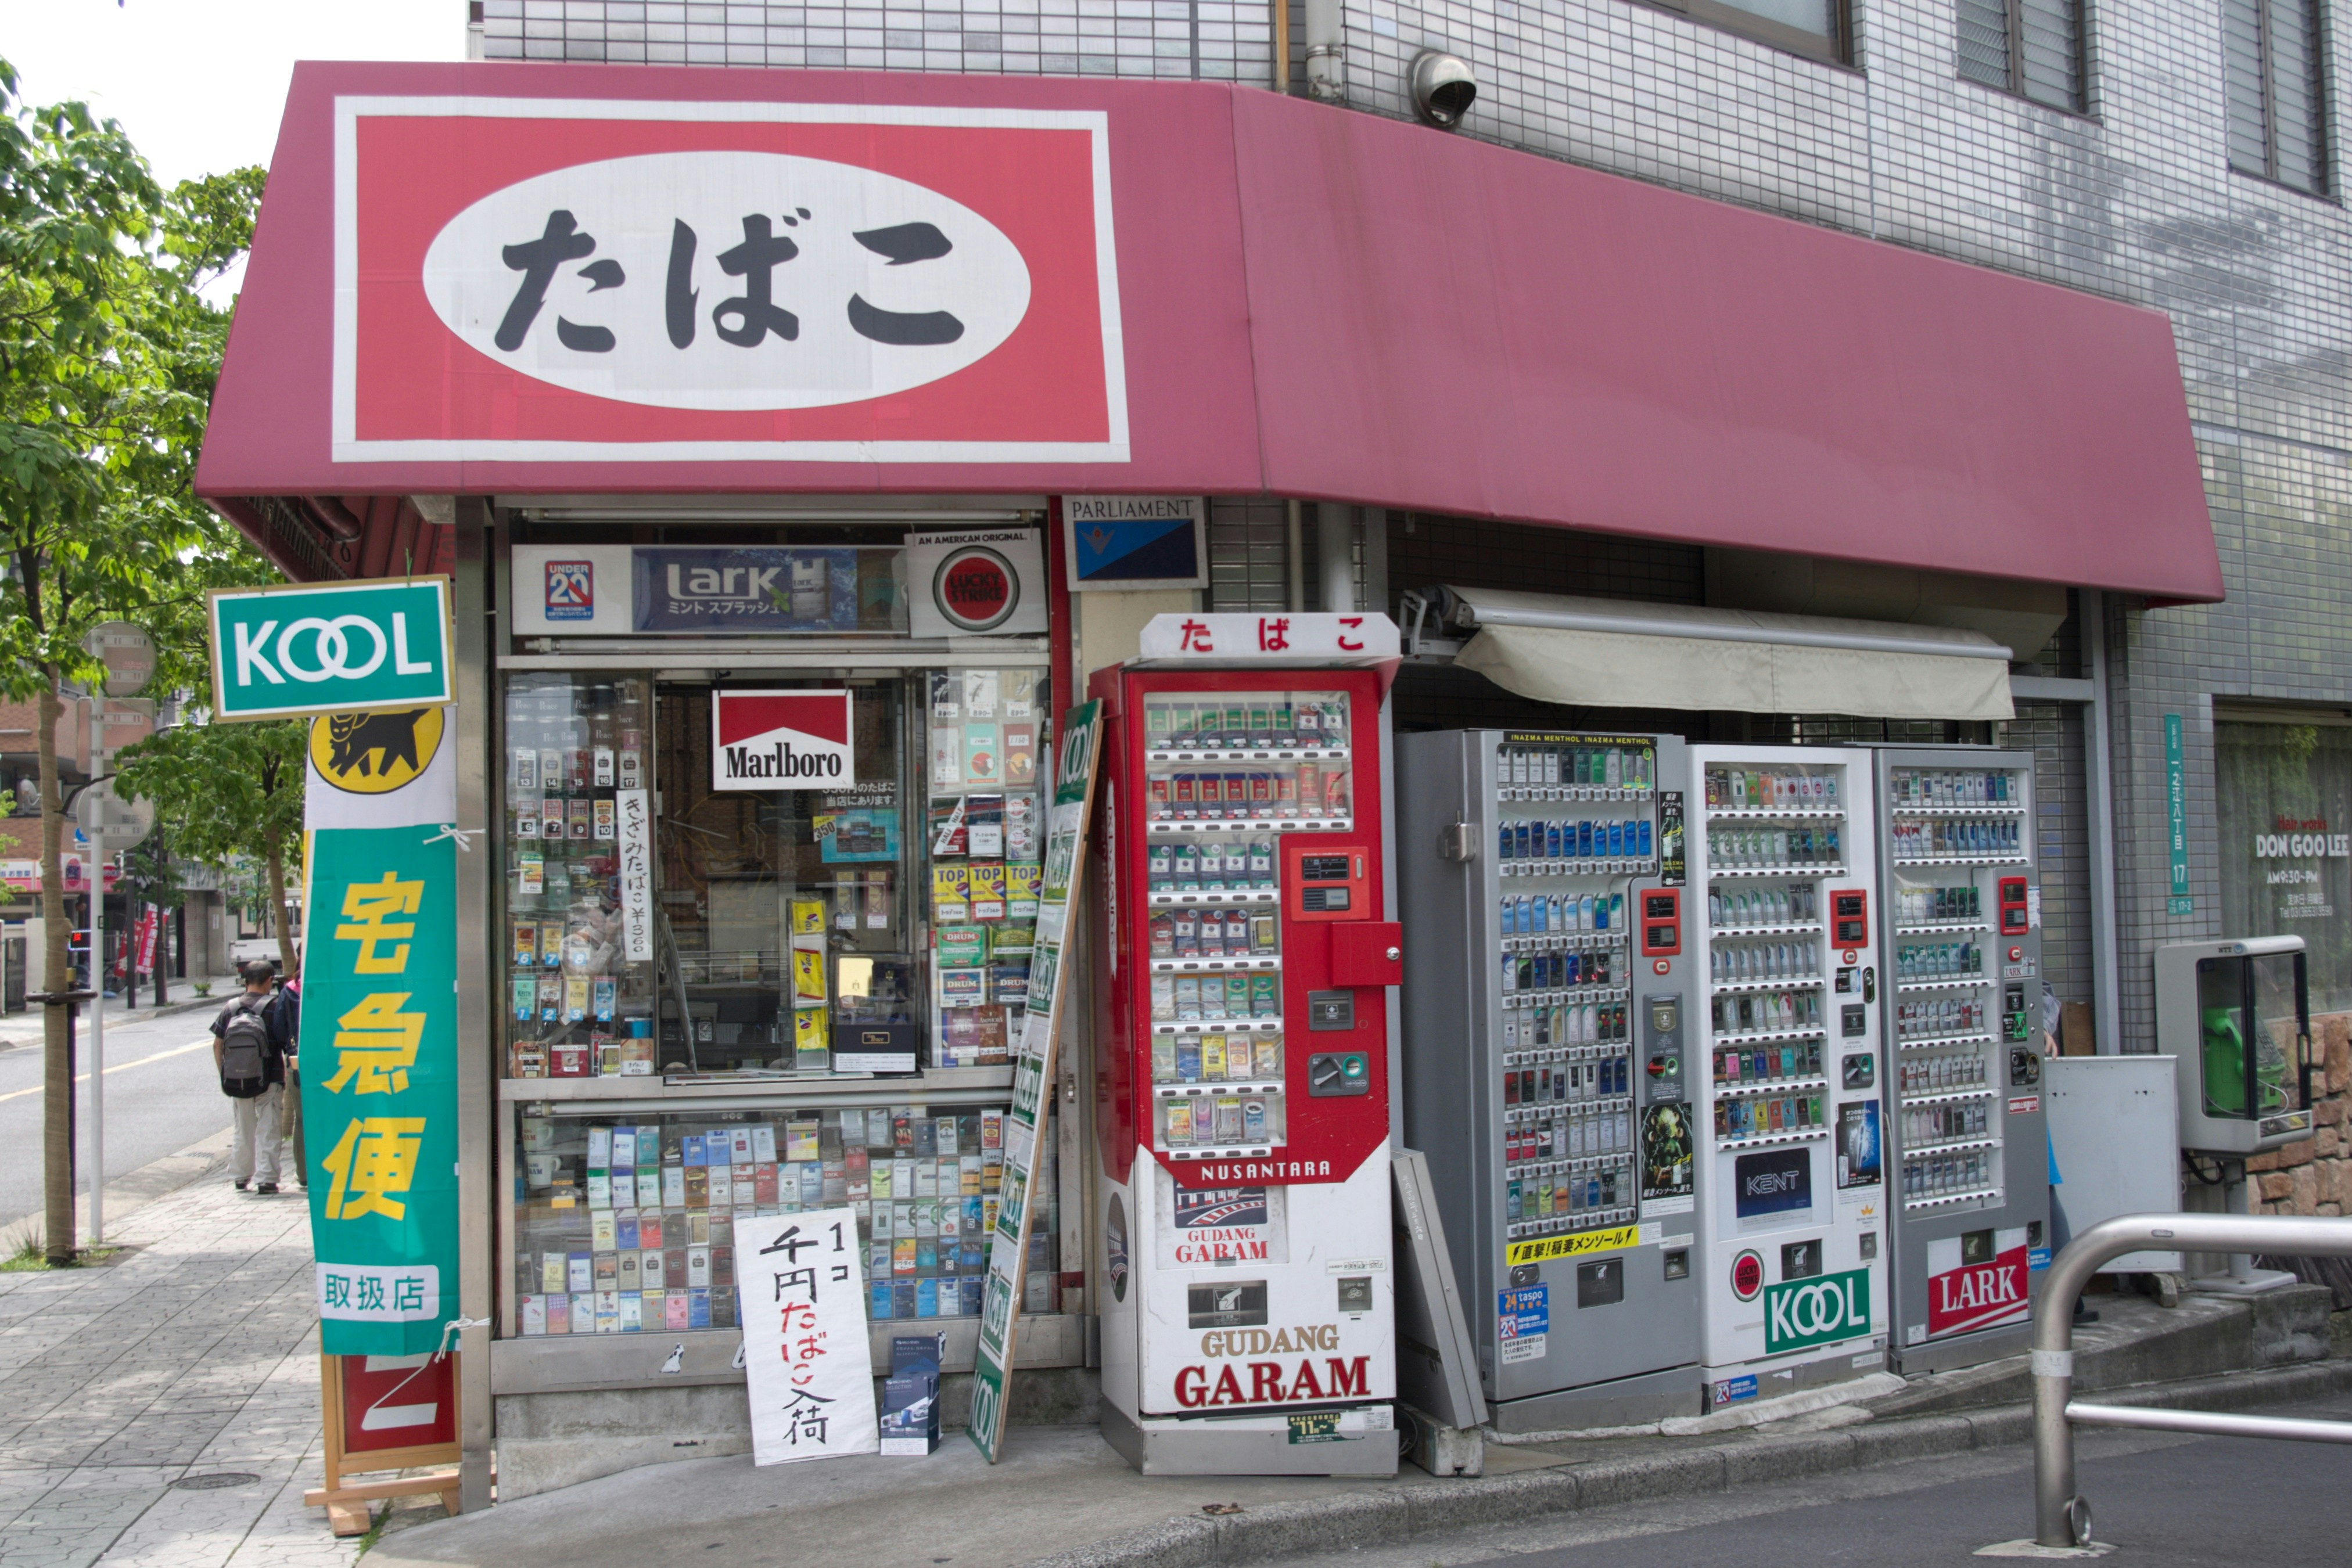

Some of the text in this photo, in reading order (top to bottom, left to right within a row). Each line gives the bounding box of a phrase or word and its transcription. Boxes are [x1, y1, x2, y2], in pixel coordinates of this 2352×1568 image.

[494, 207, 964, 352] たばこ
[1073, 500, 1193, 518] PARLIAMENT
[935, 534, 980, 544] AMERICAN
[982, 533, 1027, 542] ORIGINAL.
[550, 564, 588, 573] UNDER
[550, 573, 588, 603] 20
[950, 573, 1001, 589] LUCKY
[951, 587, 1002, 603] STRIKE
[668, 601, 780, 614] ミント スプラッシュ
[1181, 617, 1363, 652] たばこ
[234, 612, 432, 686] KOOL
[726, 743, 842, 778] Marlboro
[547, 778, 557, 786] 14
[574, 778, 583, 786] 15
[599, 776, 609, 784] 16
[826, 795, 897, 807] 当店にあります。
[951, 807, 963, 823] HALF
[2278, 814, 2328, 830] Hair works
[814, 821, 835, 839] 350
[940, 828, 953, 844] HALF
[2256, 834, 2350, 858] DON GOO LEE
[938, 869, 965, 882] TOP
[974, 868, 1001, 880] TOP
[1011, 867, 1038, 880] TOP
[2174, 864, 2185, 883] 17
[2178, 901, 2192, 911] 17-2
[520, 954, 529, 963] 6
[548, 954, 556, 963] 7
[574, 954, 584, 963] 8
[2005, 968, 2021, 977] LARK
[519, 1009, 526, 1019] 1
[545, 1009, 554, 1019] 2
[572, 1009, 580, 1019] 3
[599, 1011, 609, 1019] 4
[322, 871, 427, 1221] 宅急便
[1201, 1161, 1330, 1181] NUSANTARA
[1747, 1170, 1800, 1196] KENT
[1188, 1228, 1255, 1242] GUDANG
[1175, 1241, 1268, 1263] GARAM
[1737, 1265, 1758, 1276] LUCKY
[1737, 1275, 1758, 1288] STRIKE
[1940, 1265, 2018, 1313] LARK
[325, 1274, 425, 1311] 取扱店
[1518, 1290, 1543, 1302] taspo
[1771, 1277, 1866, 1342] KOOL
[1201, 1324, 1340, 1358] GUDANG
[1173, 1355, 1371, 1408] GARAM
